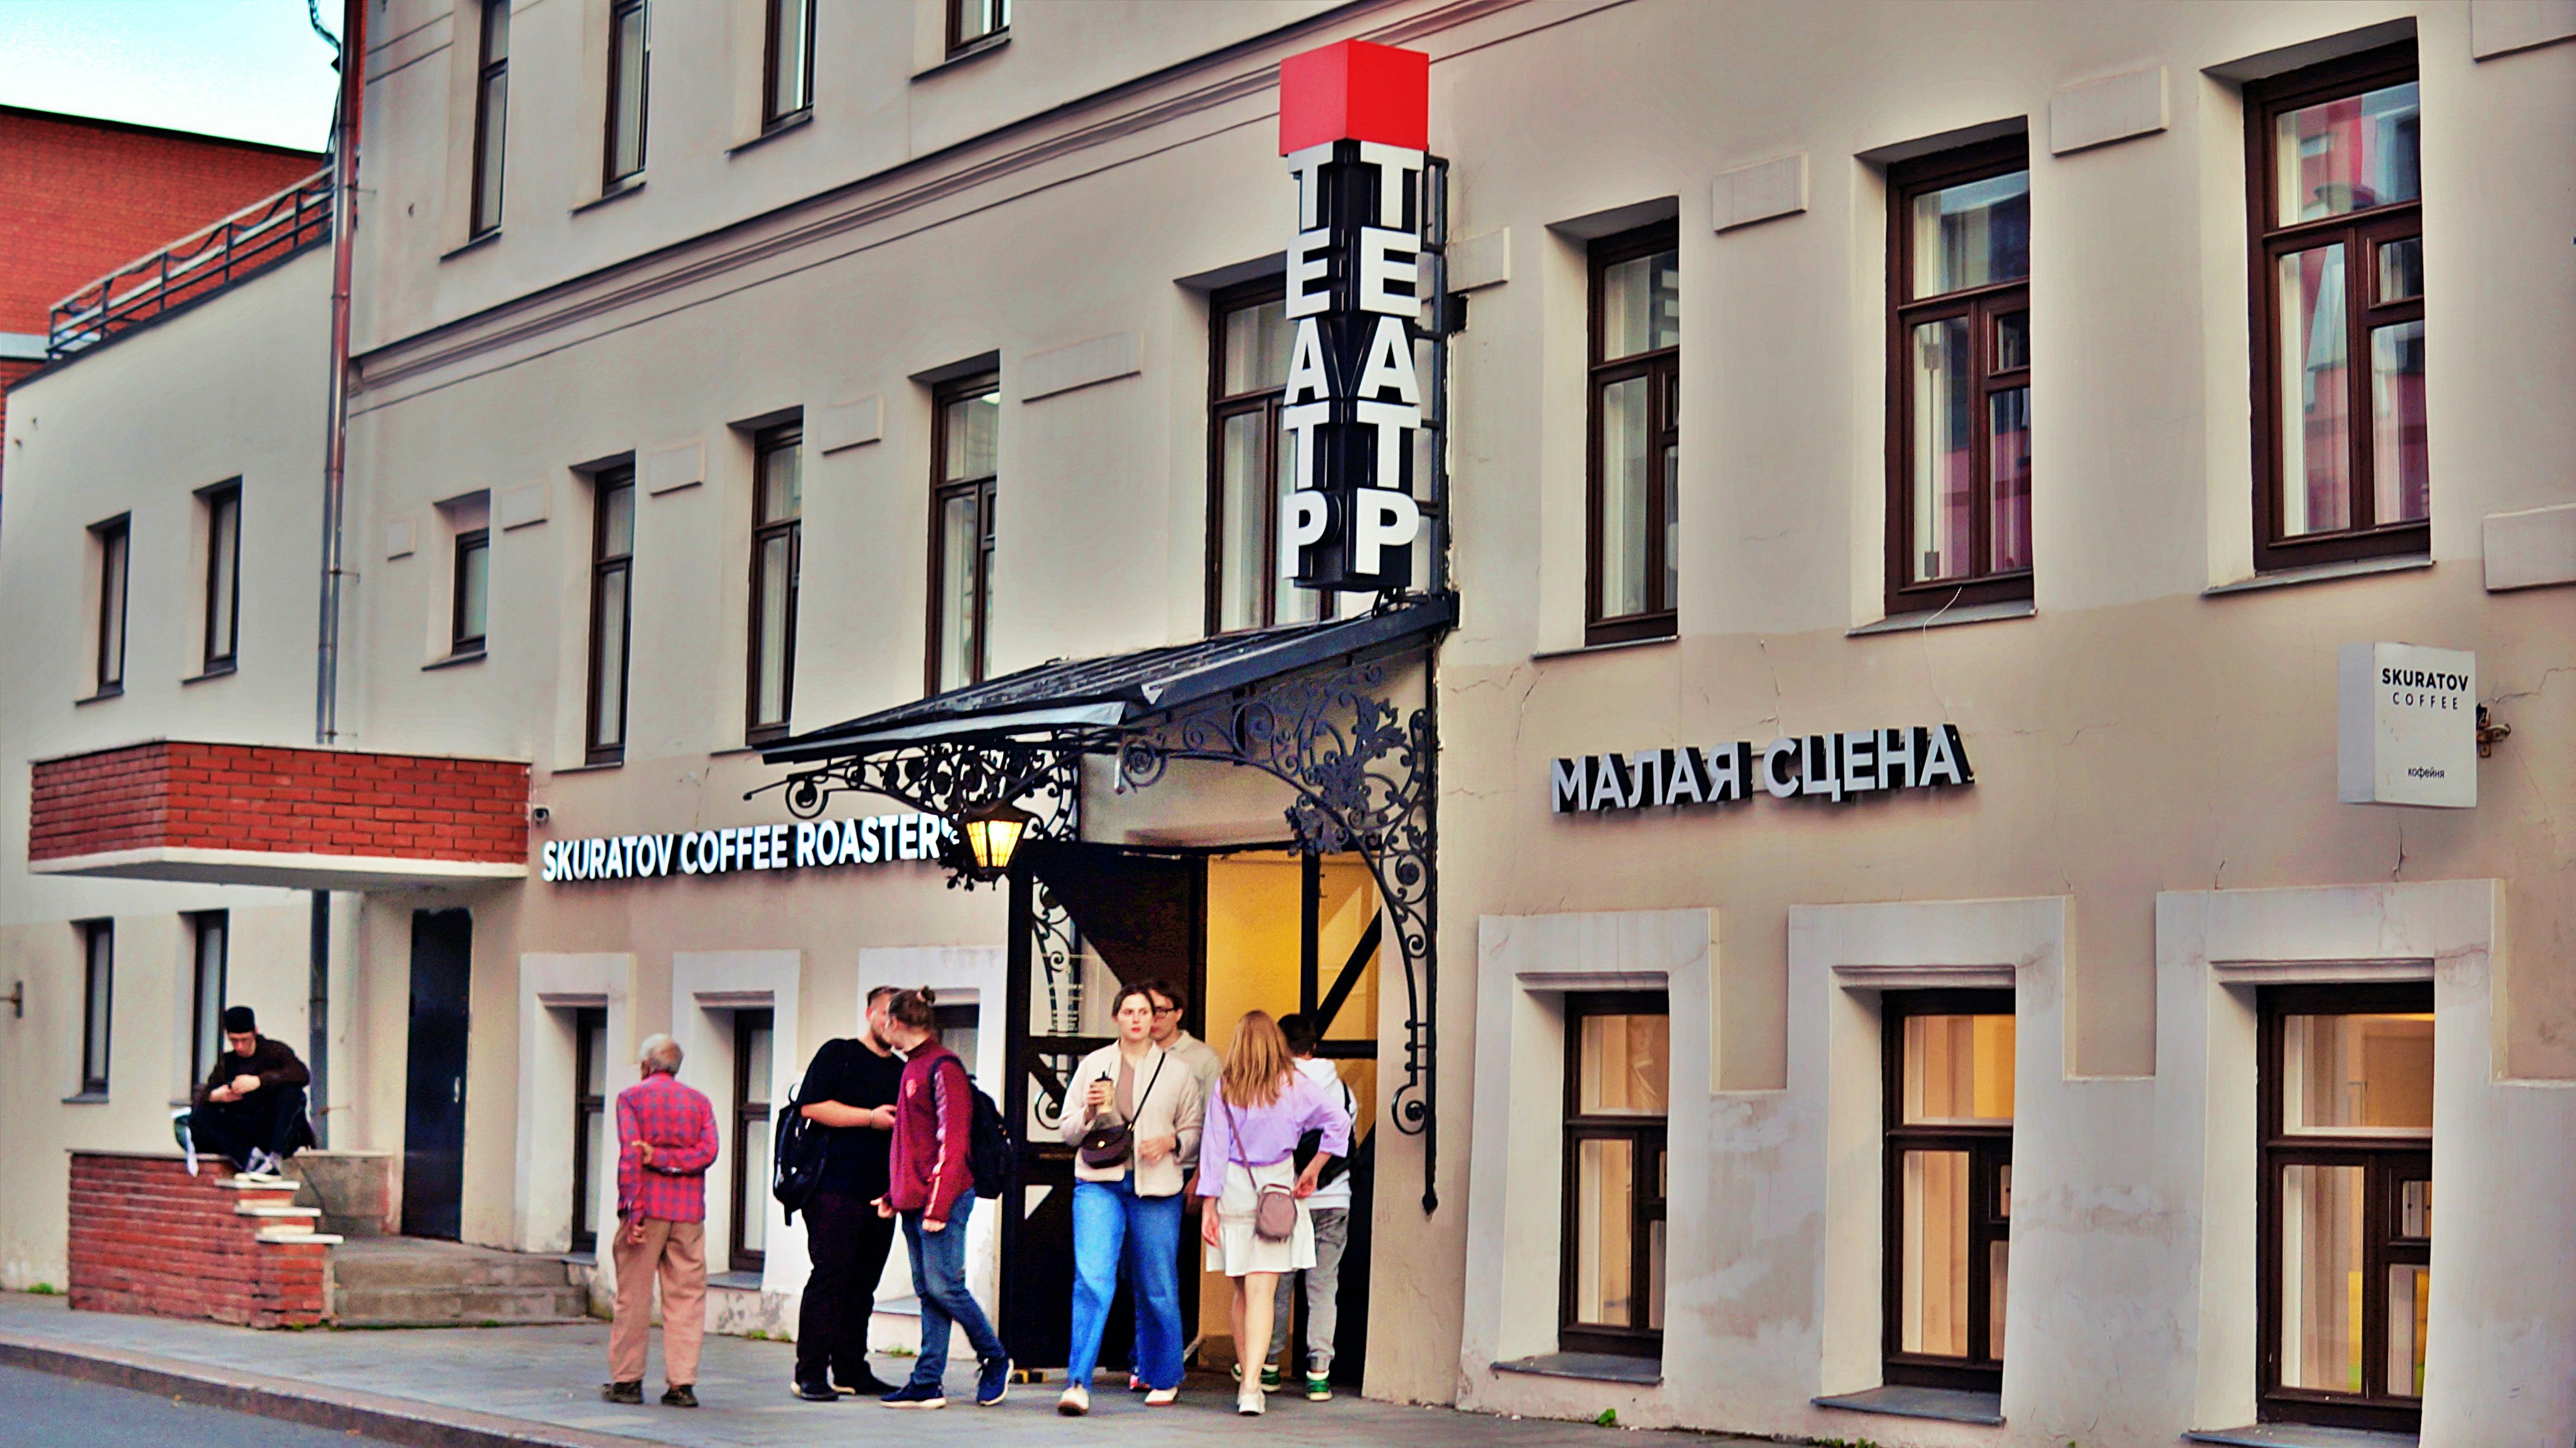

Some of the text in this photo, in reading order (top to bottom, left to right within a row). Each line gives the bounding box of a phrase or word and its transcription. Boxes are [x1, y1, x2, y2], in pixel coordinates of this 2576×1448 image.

[1283, 141, 1334, 580] ТЕАТР
[1354, 141, 1423, 576] ТЕАТР
[2381, 667, 2469, 691] SKURATOV
[2393, 691, 2458, 710] COFFEE
[1551, 723, 1974, 814] МАЛАЯ СЦЕНА
[2408, 766, 2445, 779] кофейня
[541, 833, 675, 883] SKURATOV
[678, 824, 789, 874] COFFEE
